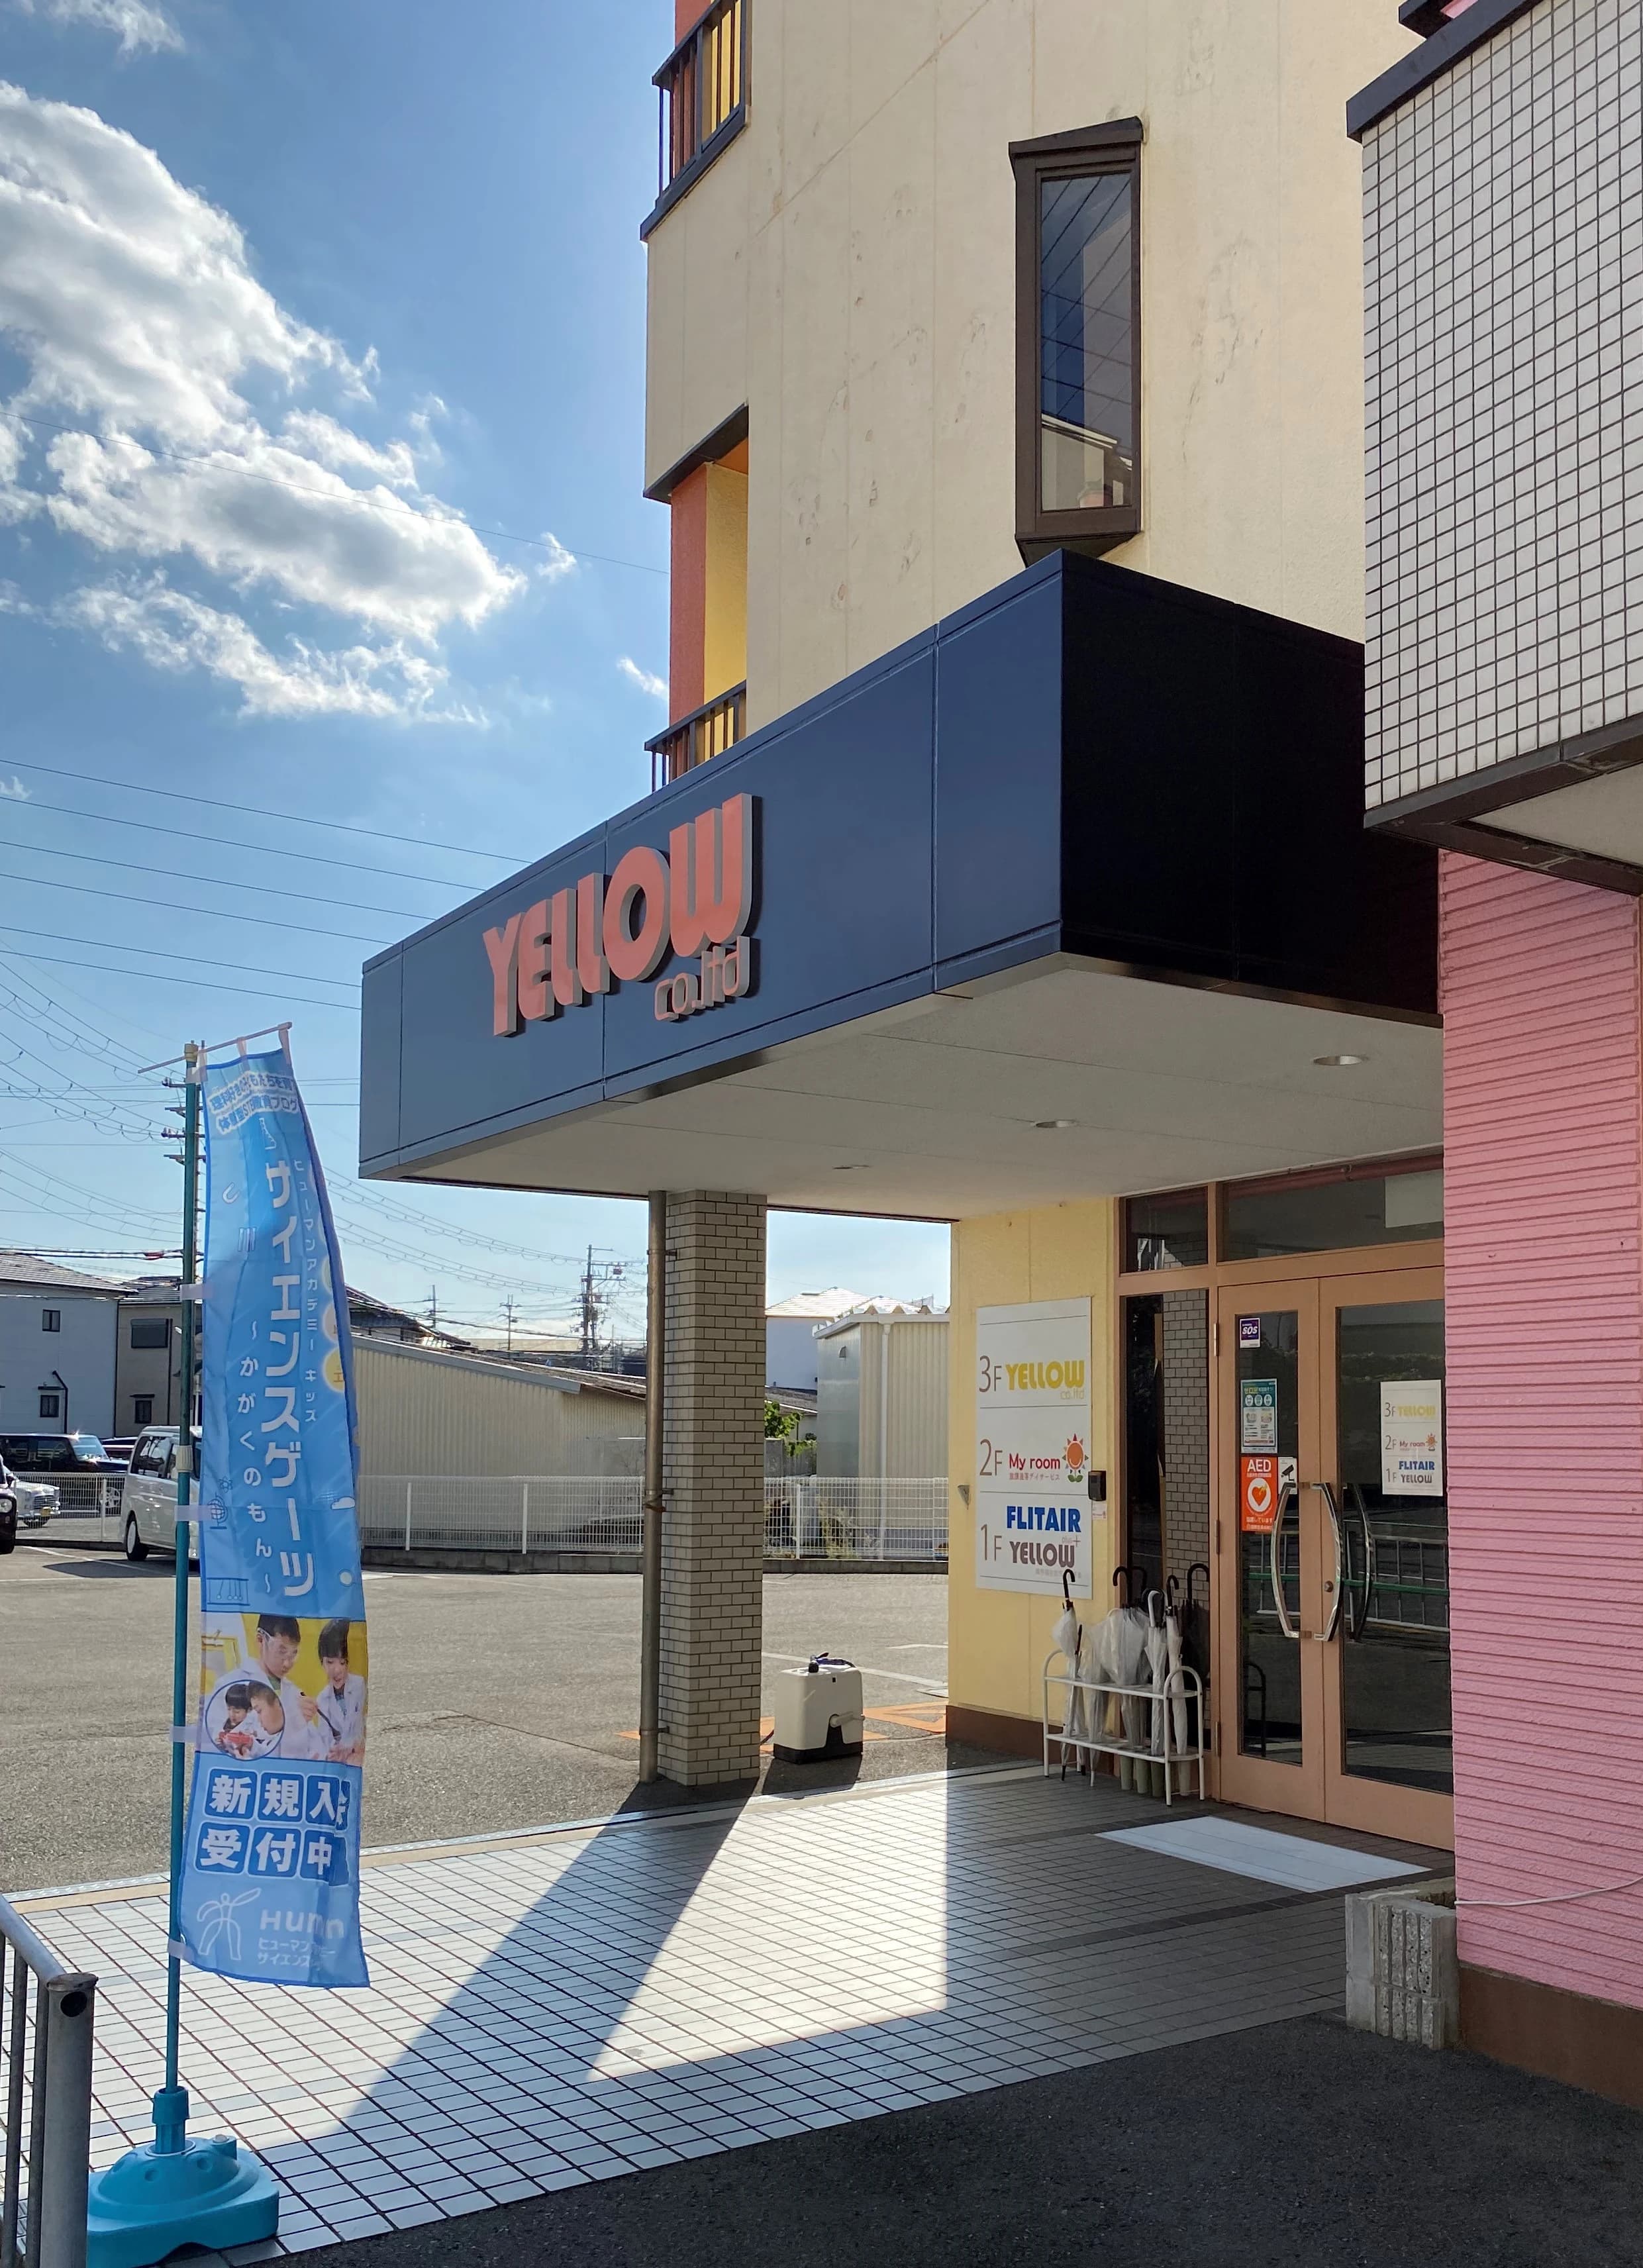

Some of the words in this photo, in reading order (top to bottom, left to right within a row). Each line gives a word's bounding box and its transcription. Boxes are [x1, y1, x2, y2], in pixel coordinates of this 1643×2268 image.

[482, 793, 752, 1037] YELLOW
[1242, 1326, 1258, 1335] SOS
[260, 1159, 316, 1597] サイエンスゲーツ
[979, 1355, 1002, 1392] 3F
[1005, 1359, 1085, 1390] YELLOW
[980, 1438, 1003, 1477] 2F
[1009, 1454, 1026, 1471] My
[1030, 1458, 1060, 1469] room
[1247, 1459, 1271, 1473] AED
[1399, 1461, 1435, 1471] FLITAIR
[1401, 1474, 1432, 1483] YELLOW
[1007, 1506, 1081, 1533] FLITAIR
[1009, 1540, 1075, 1568] YELLOW
